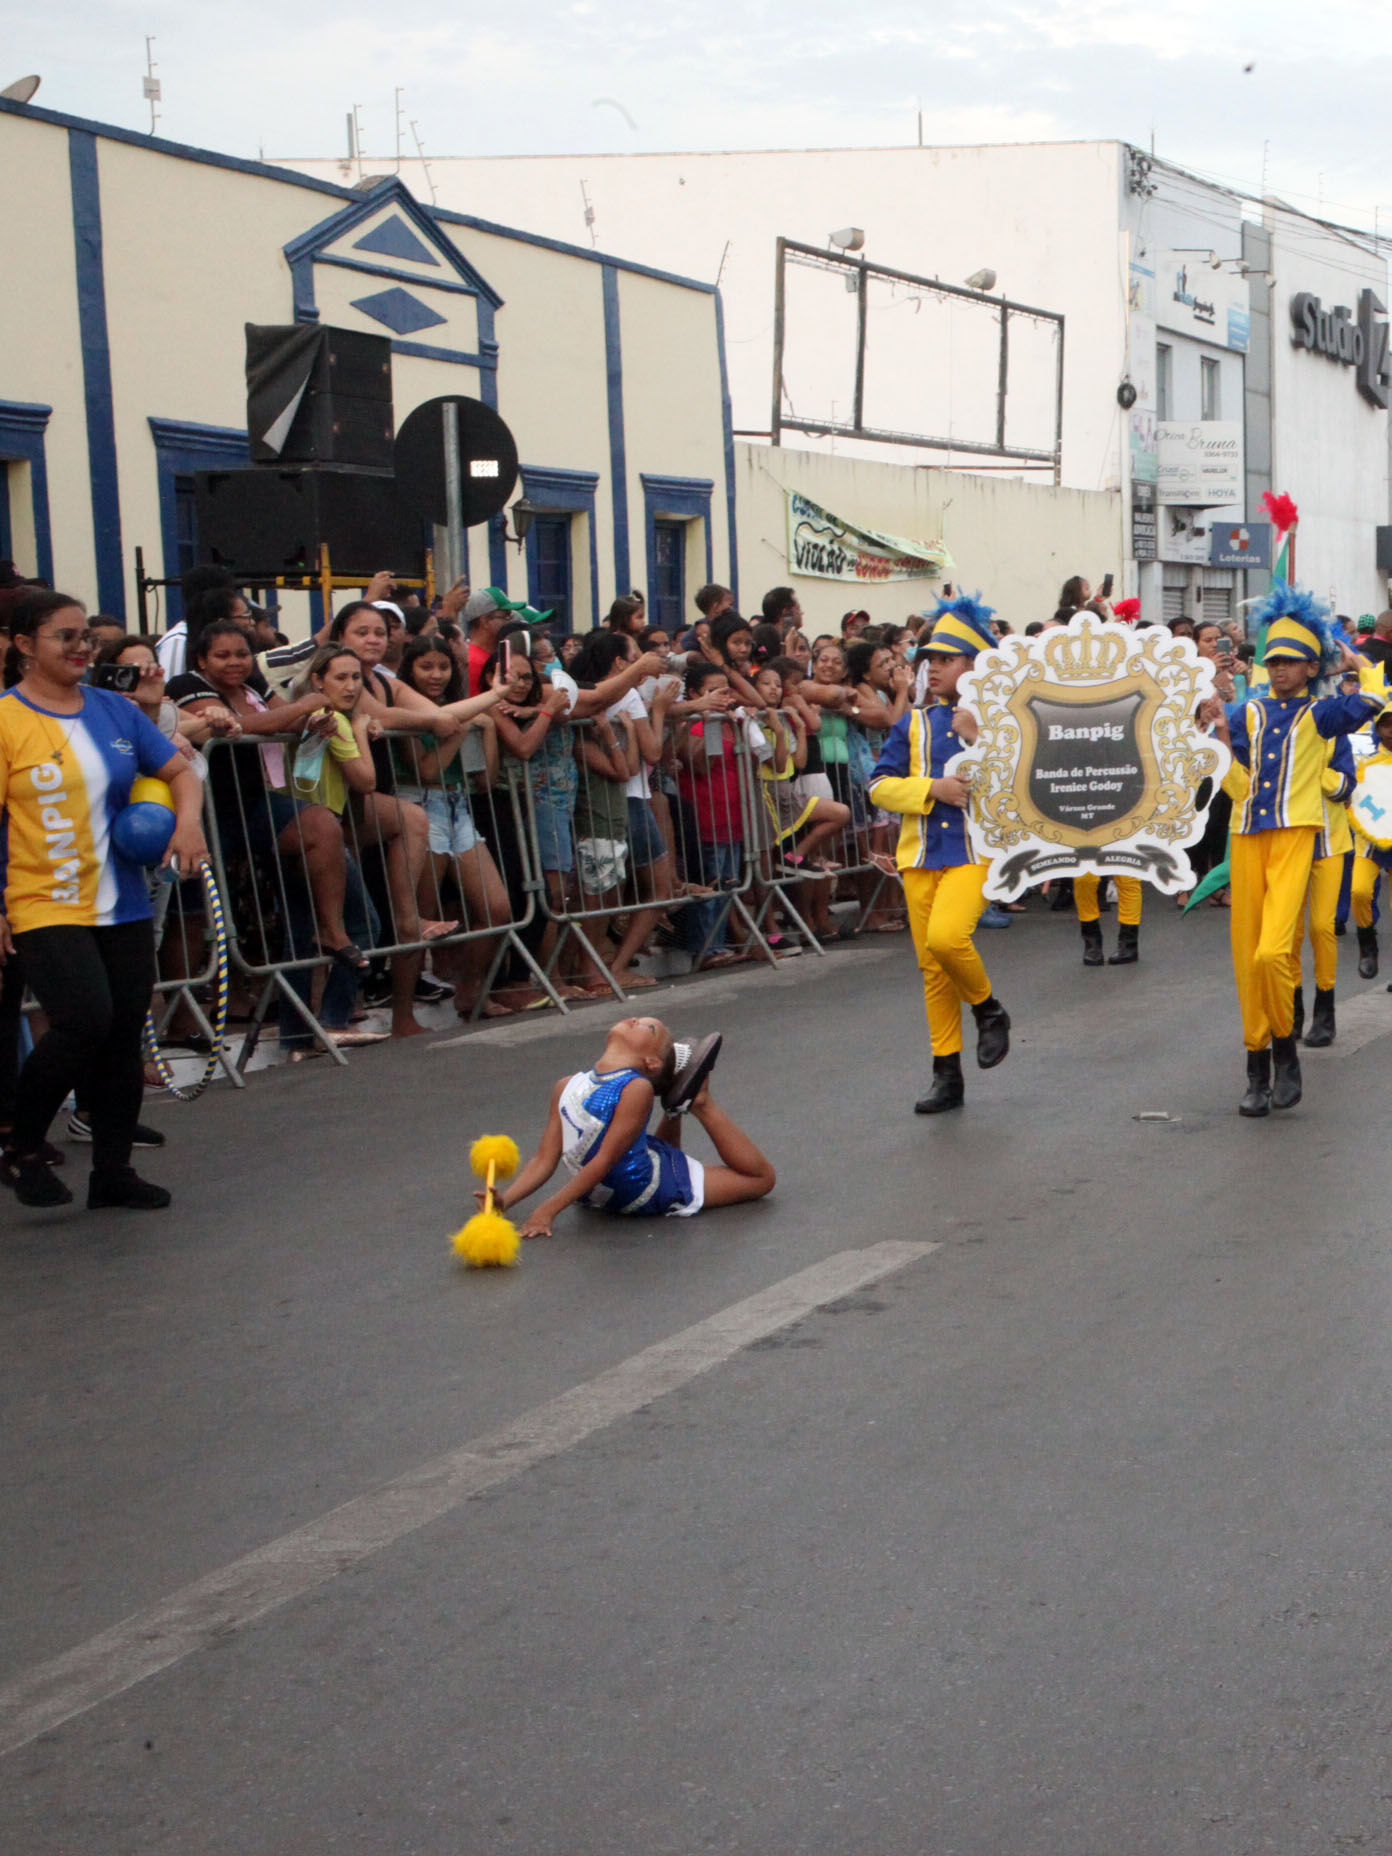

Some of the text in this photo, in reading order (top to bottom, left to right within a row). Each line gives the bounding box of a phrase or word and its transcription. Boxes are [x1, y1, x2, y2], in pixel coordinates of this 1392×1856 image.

[1290, 291, 1364, 366] Studio
[1186, 427, 1237, 449] Bruna
[1220, 554, 1260, 563] Loterias
[1048, 722, 1125, 742] Banpig
[1035, 764, 1138, 780] Banda de Percussão
[1050, 780, 1124, 793] Irenice Godoy
[1087, 803, 1116, 811] Grande
[1080, 812, 1095, 820] MT
[1104, 855, 1142, 866] ALEGRIA
